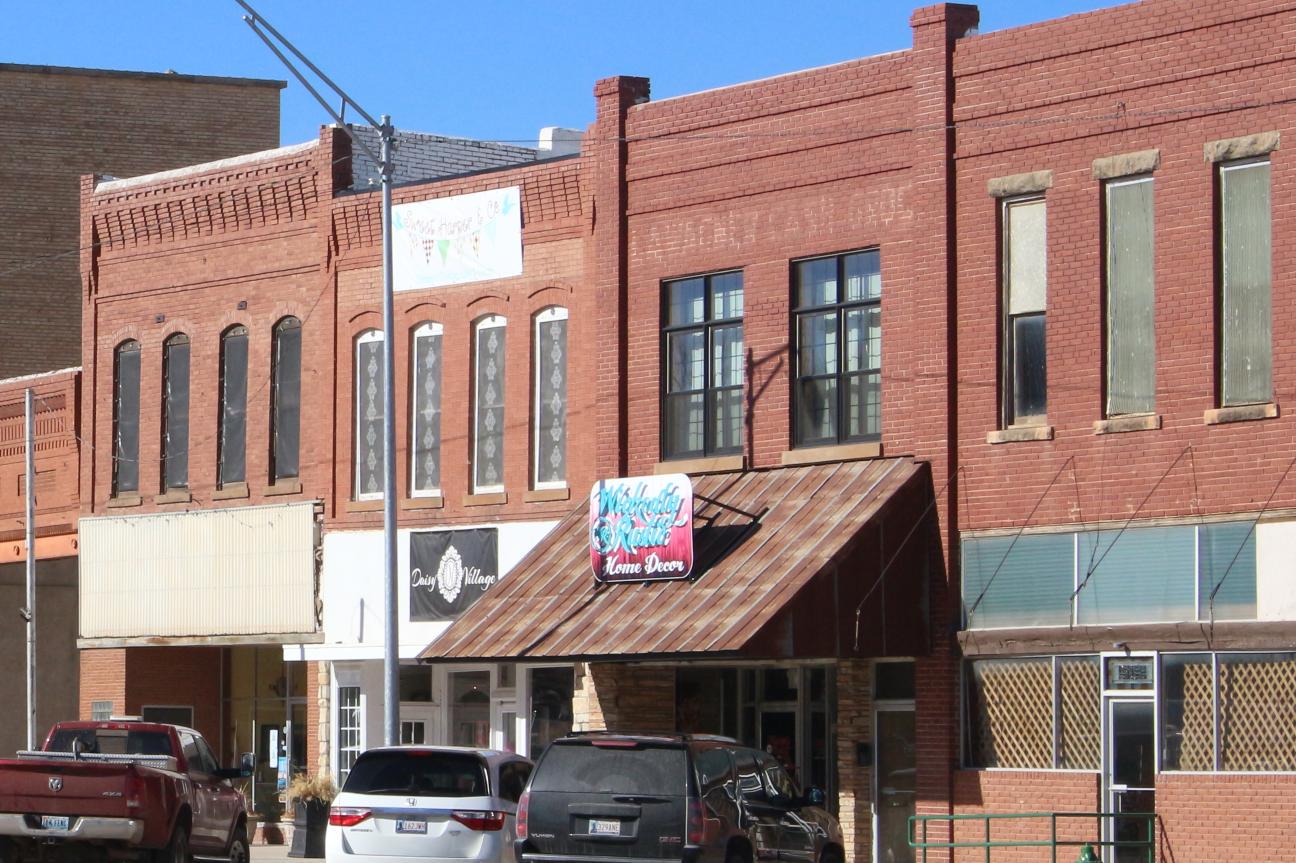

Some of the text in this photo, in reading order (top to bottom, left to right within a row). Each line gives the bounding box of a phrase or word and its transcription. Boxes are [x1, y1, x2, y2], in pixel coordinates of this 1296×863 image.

[614, 513, 672, 554] Rustic
[604, 552, 685, 576] Home Decor
[411, 566, 496, 592] Daisy Village
